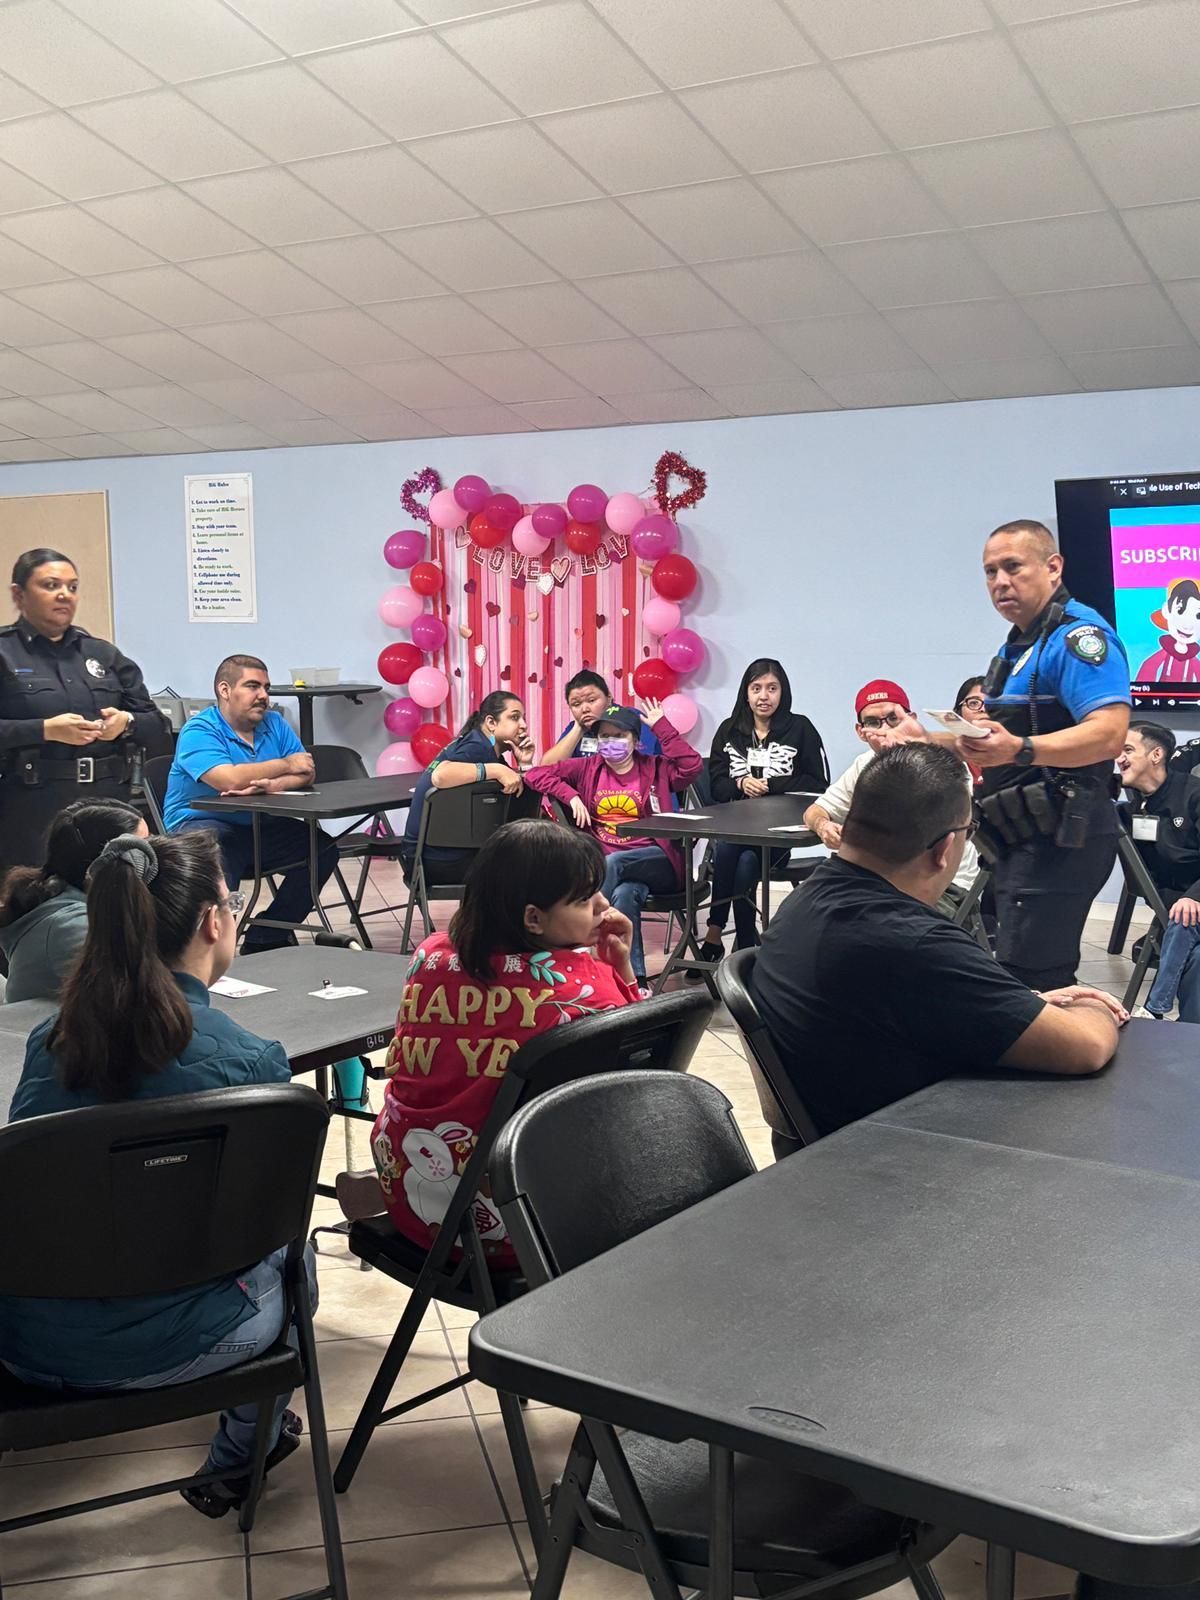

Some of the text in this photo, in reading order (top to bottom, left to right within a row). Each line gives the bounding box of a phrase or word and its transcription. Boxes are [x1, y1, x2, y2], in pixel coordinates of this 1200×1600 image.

[1159, 483, 1173, 491] Use
[1175, 482, 1183, 491] of
[472, 545, 541, 583] LOVE
[1120, 545, 1200, 565] SUBSCRI
[400, 983, 555, 1028] HAPPY
[384, 1036, 520, 1078] EW YE
